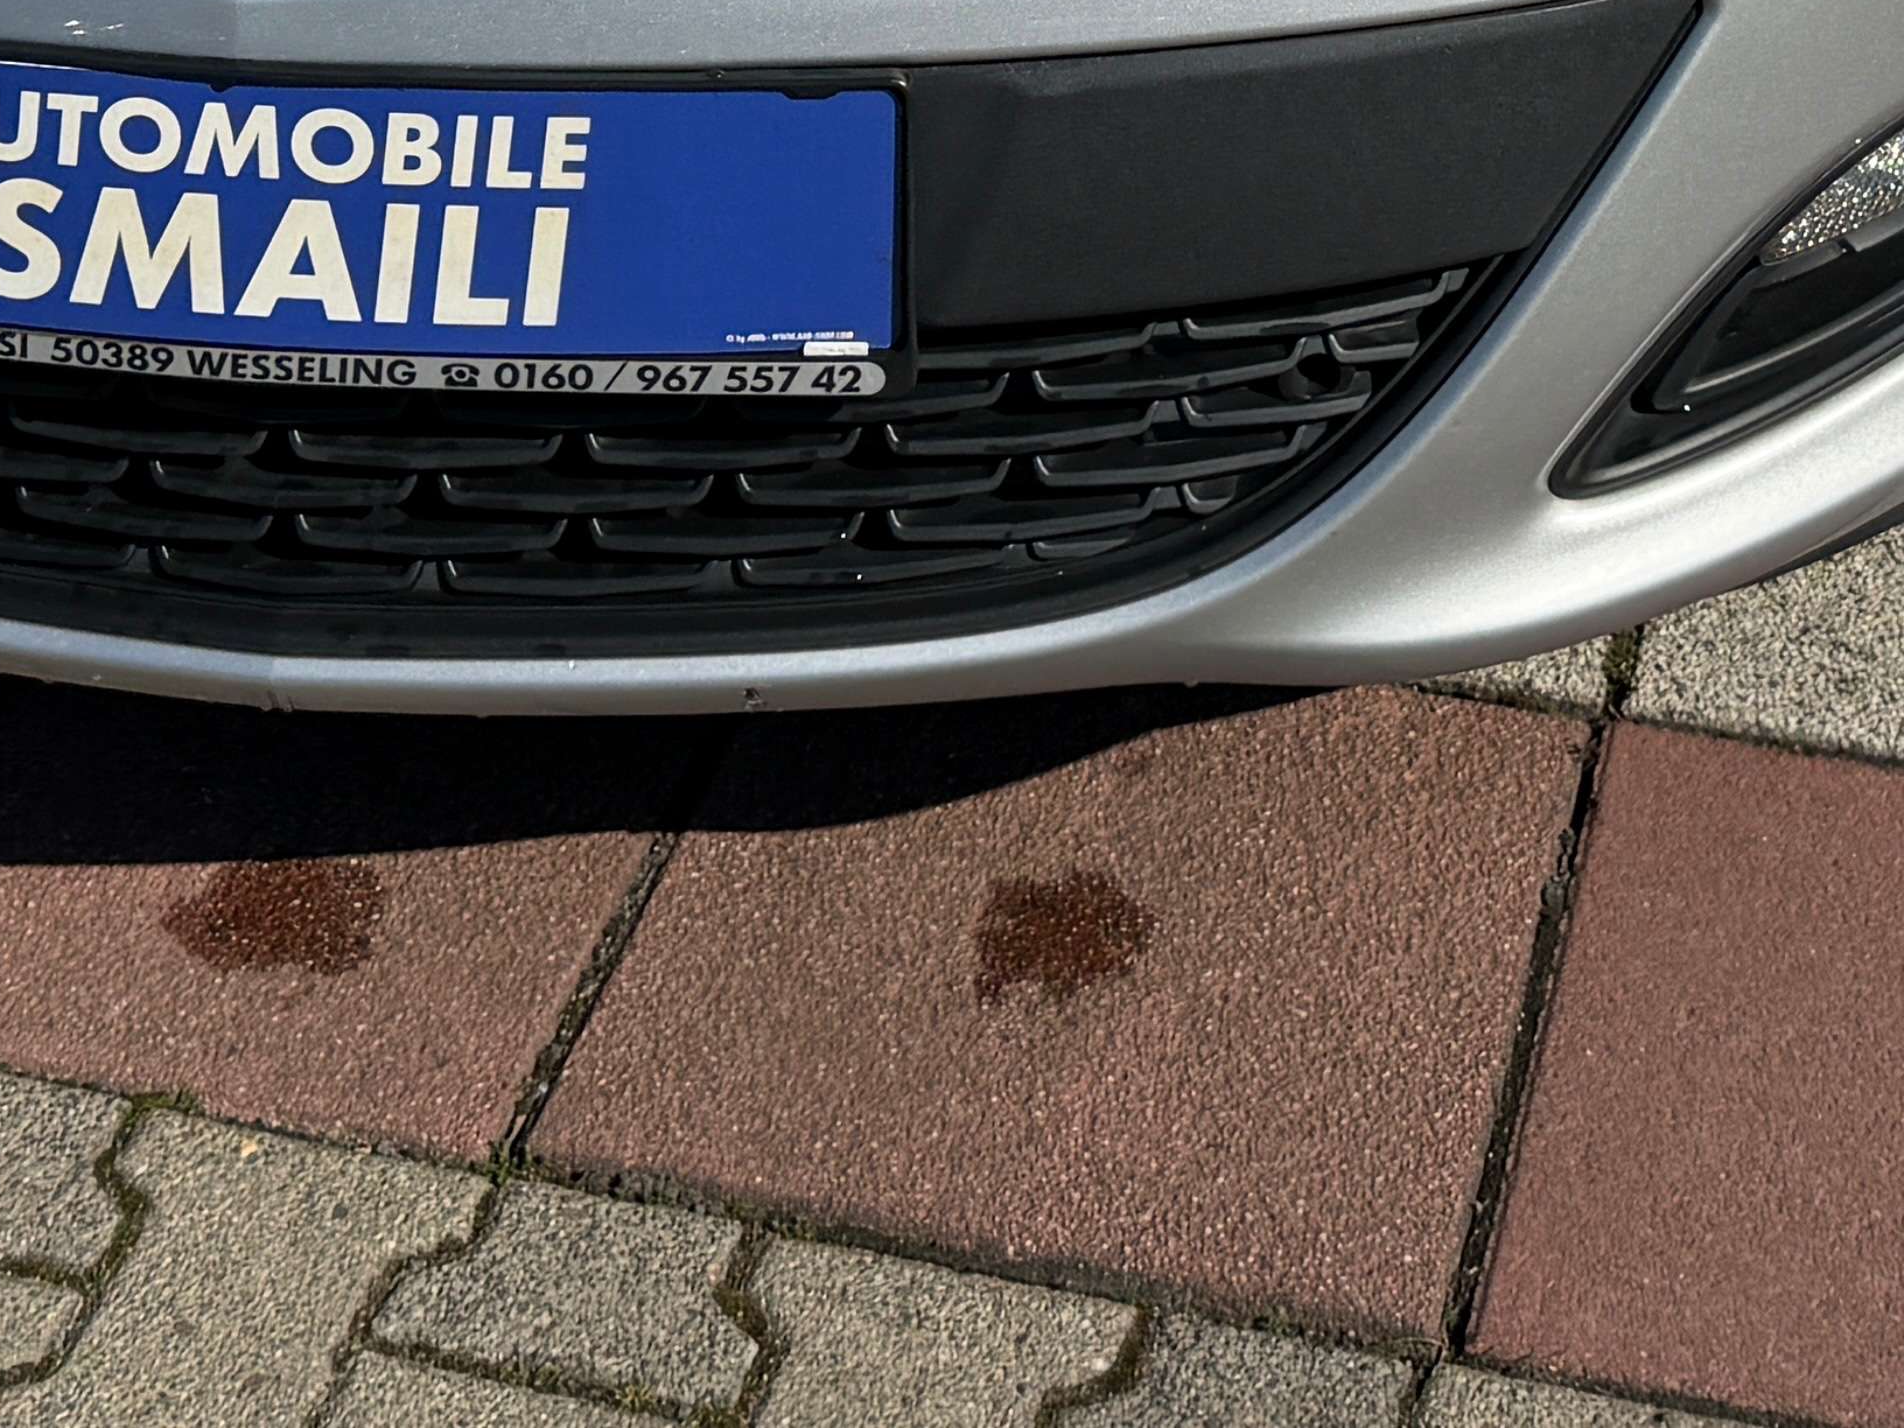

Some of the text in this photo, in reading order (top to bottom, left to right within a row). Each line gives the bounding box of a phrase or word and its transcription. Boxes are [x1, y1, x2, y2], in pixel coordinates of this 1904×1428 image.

[50, 336, 175, 372] 50389
[185, 349, 417, 386] WESSELING
[494, 363, 594, 391] 0160
[637, 364, 710, 393] 967
[723, 364, 798, 393] 557
[811, 365, 863, 393] 42
